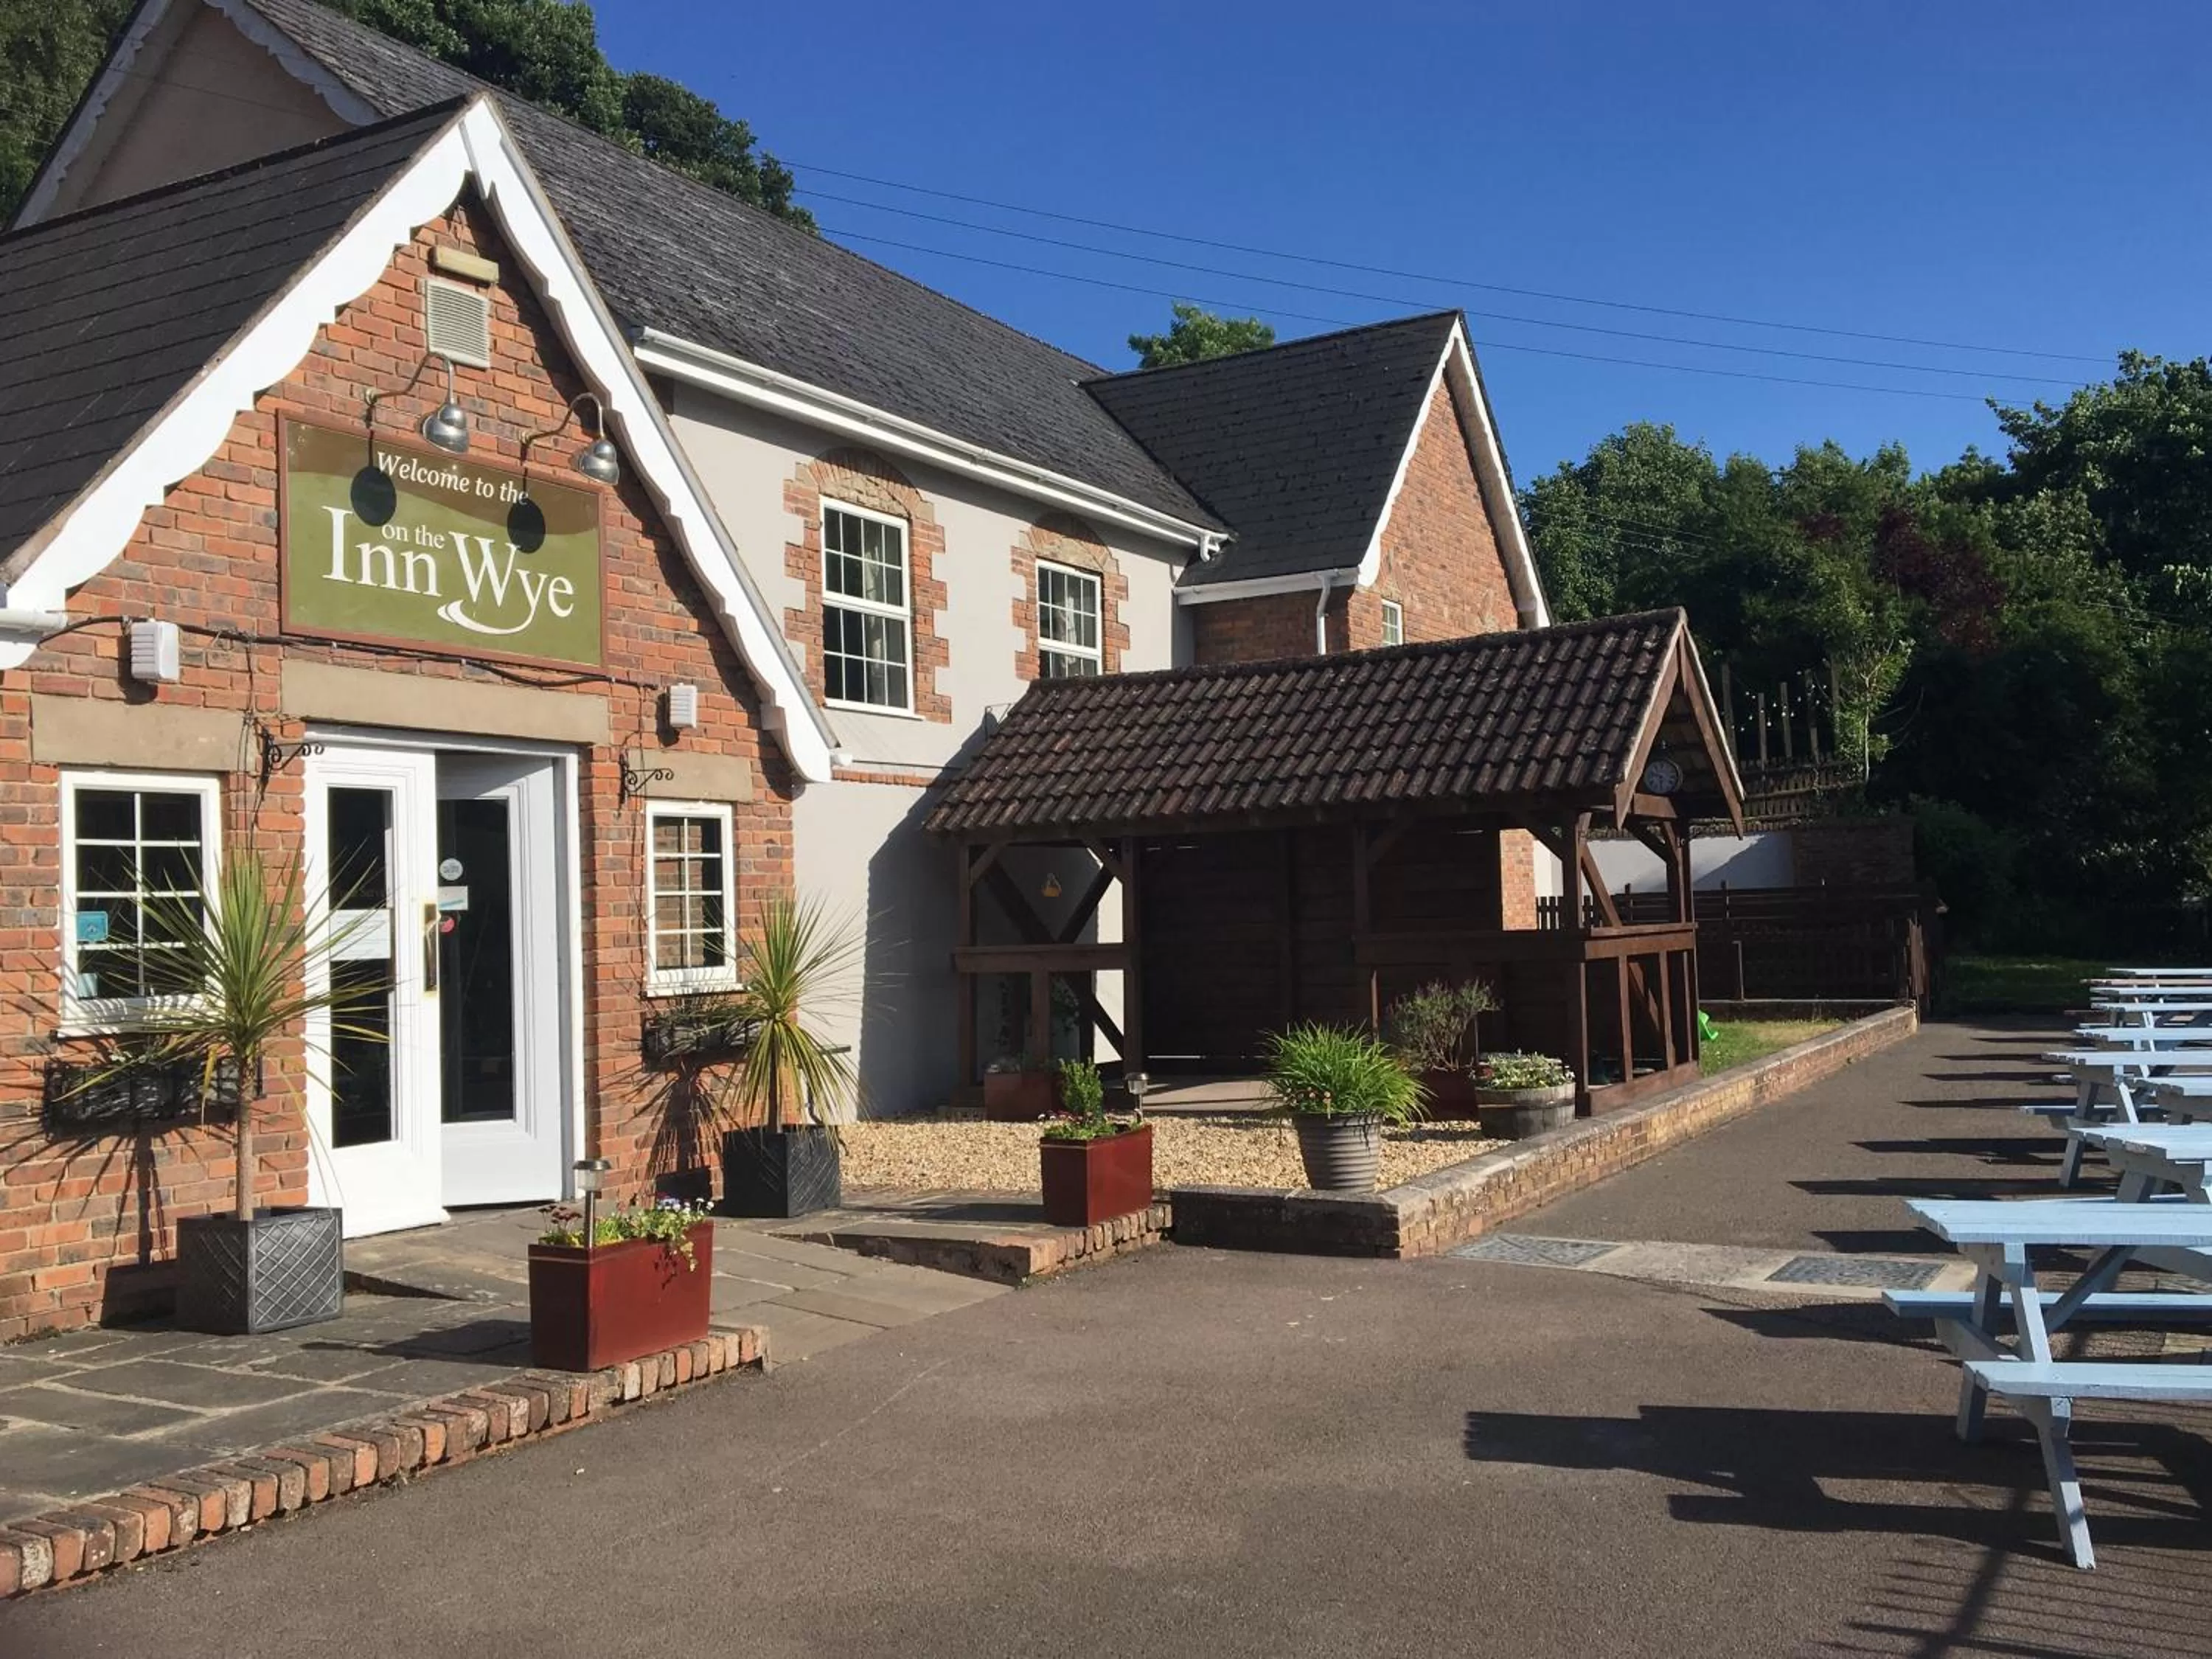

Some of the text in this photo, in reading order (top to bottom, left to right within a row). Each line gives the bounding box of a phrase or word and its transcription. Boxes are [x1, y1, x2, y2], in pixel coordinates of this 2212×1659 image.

[377, 451, 529, 505] Welcome to the
[381, 524, 445, 549] on the
[321, 505, 574, 635] Inn Wye
